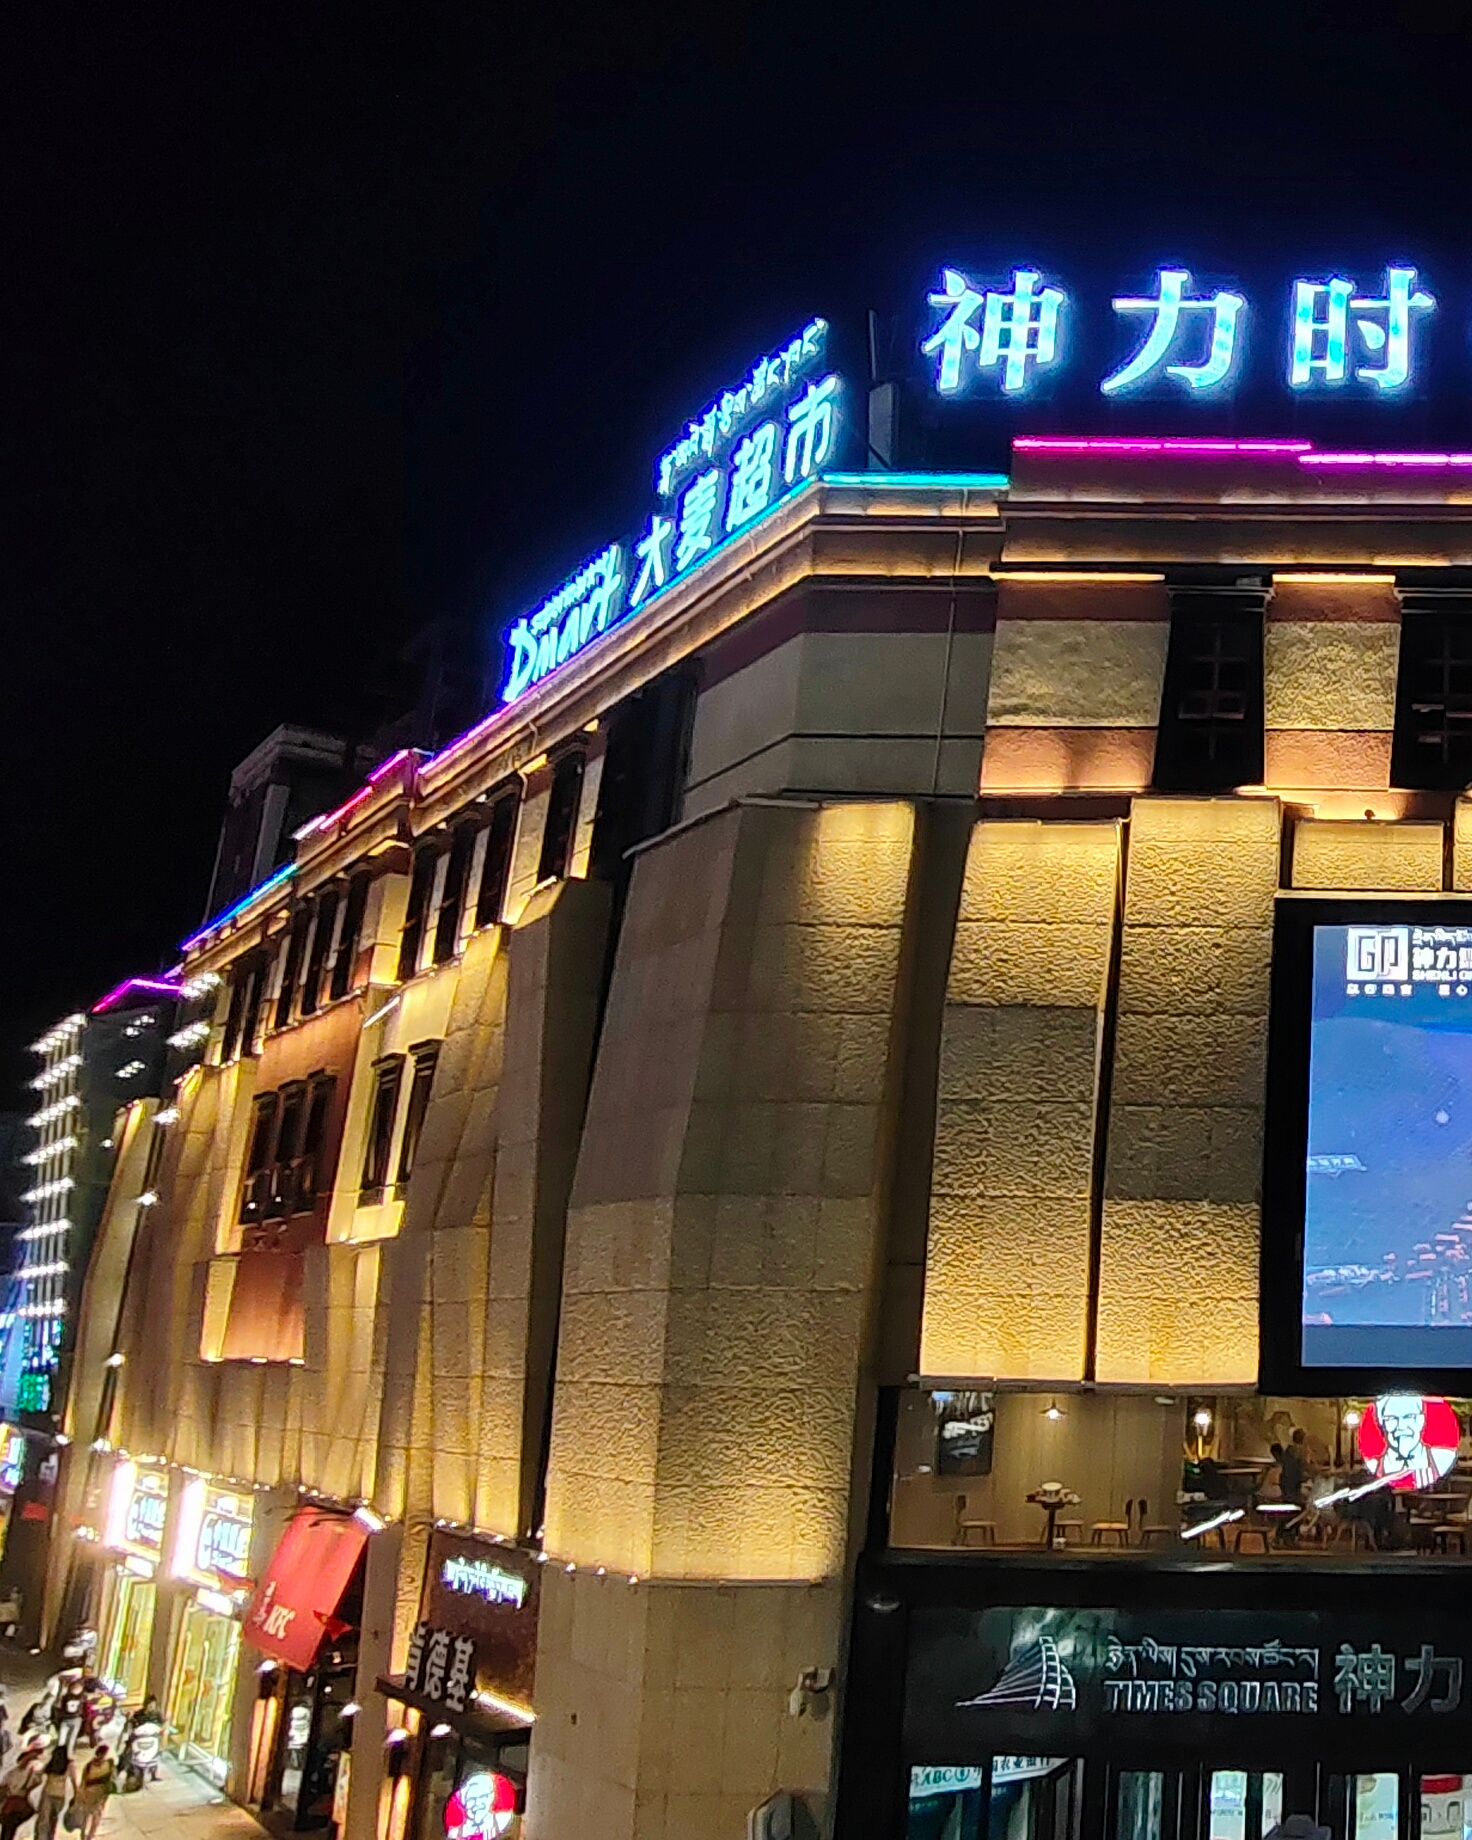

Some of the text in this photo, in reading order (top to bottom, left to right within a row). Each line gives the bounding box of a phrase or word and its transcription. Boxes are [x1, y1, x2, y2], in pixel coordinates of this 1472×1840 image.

[630, 374, 838, 607] 大麦超市
[405, 1616, 476, 1712] 肯德基
[1104, 1680, 1319, 1714] TIMES SQUARE
